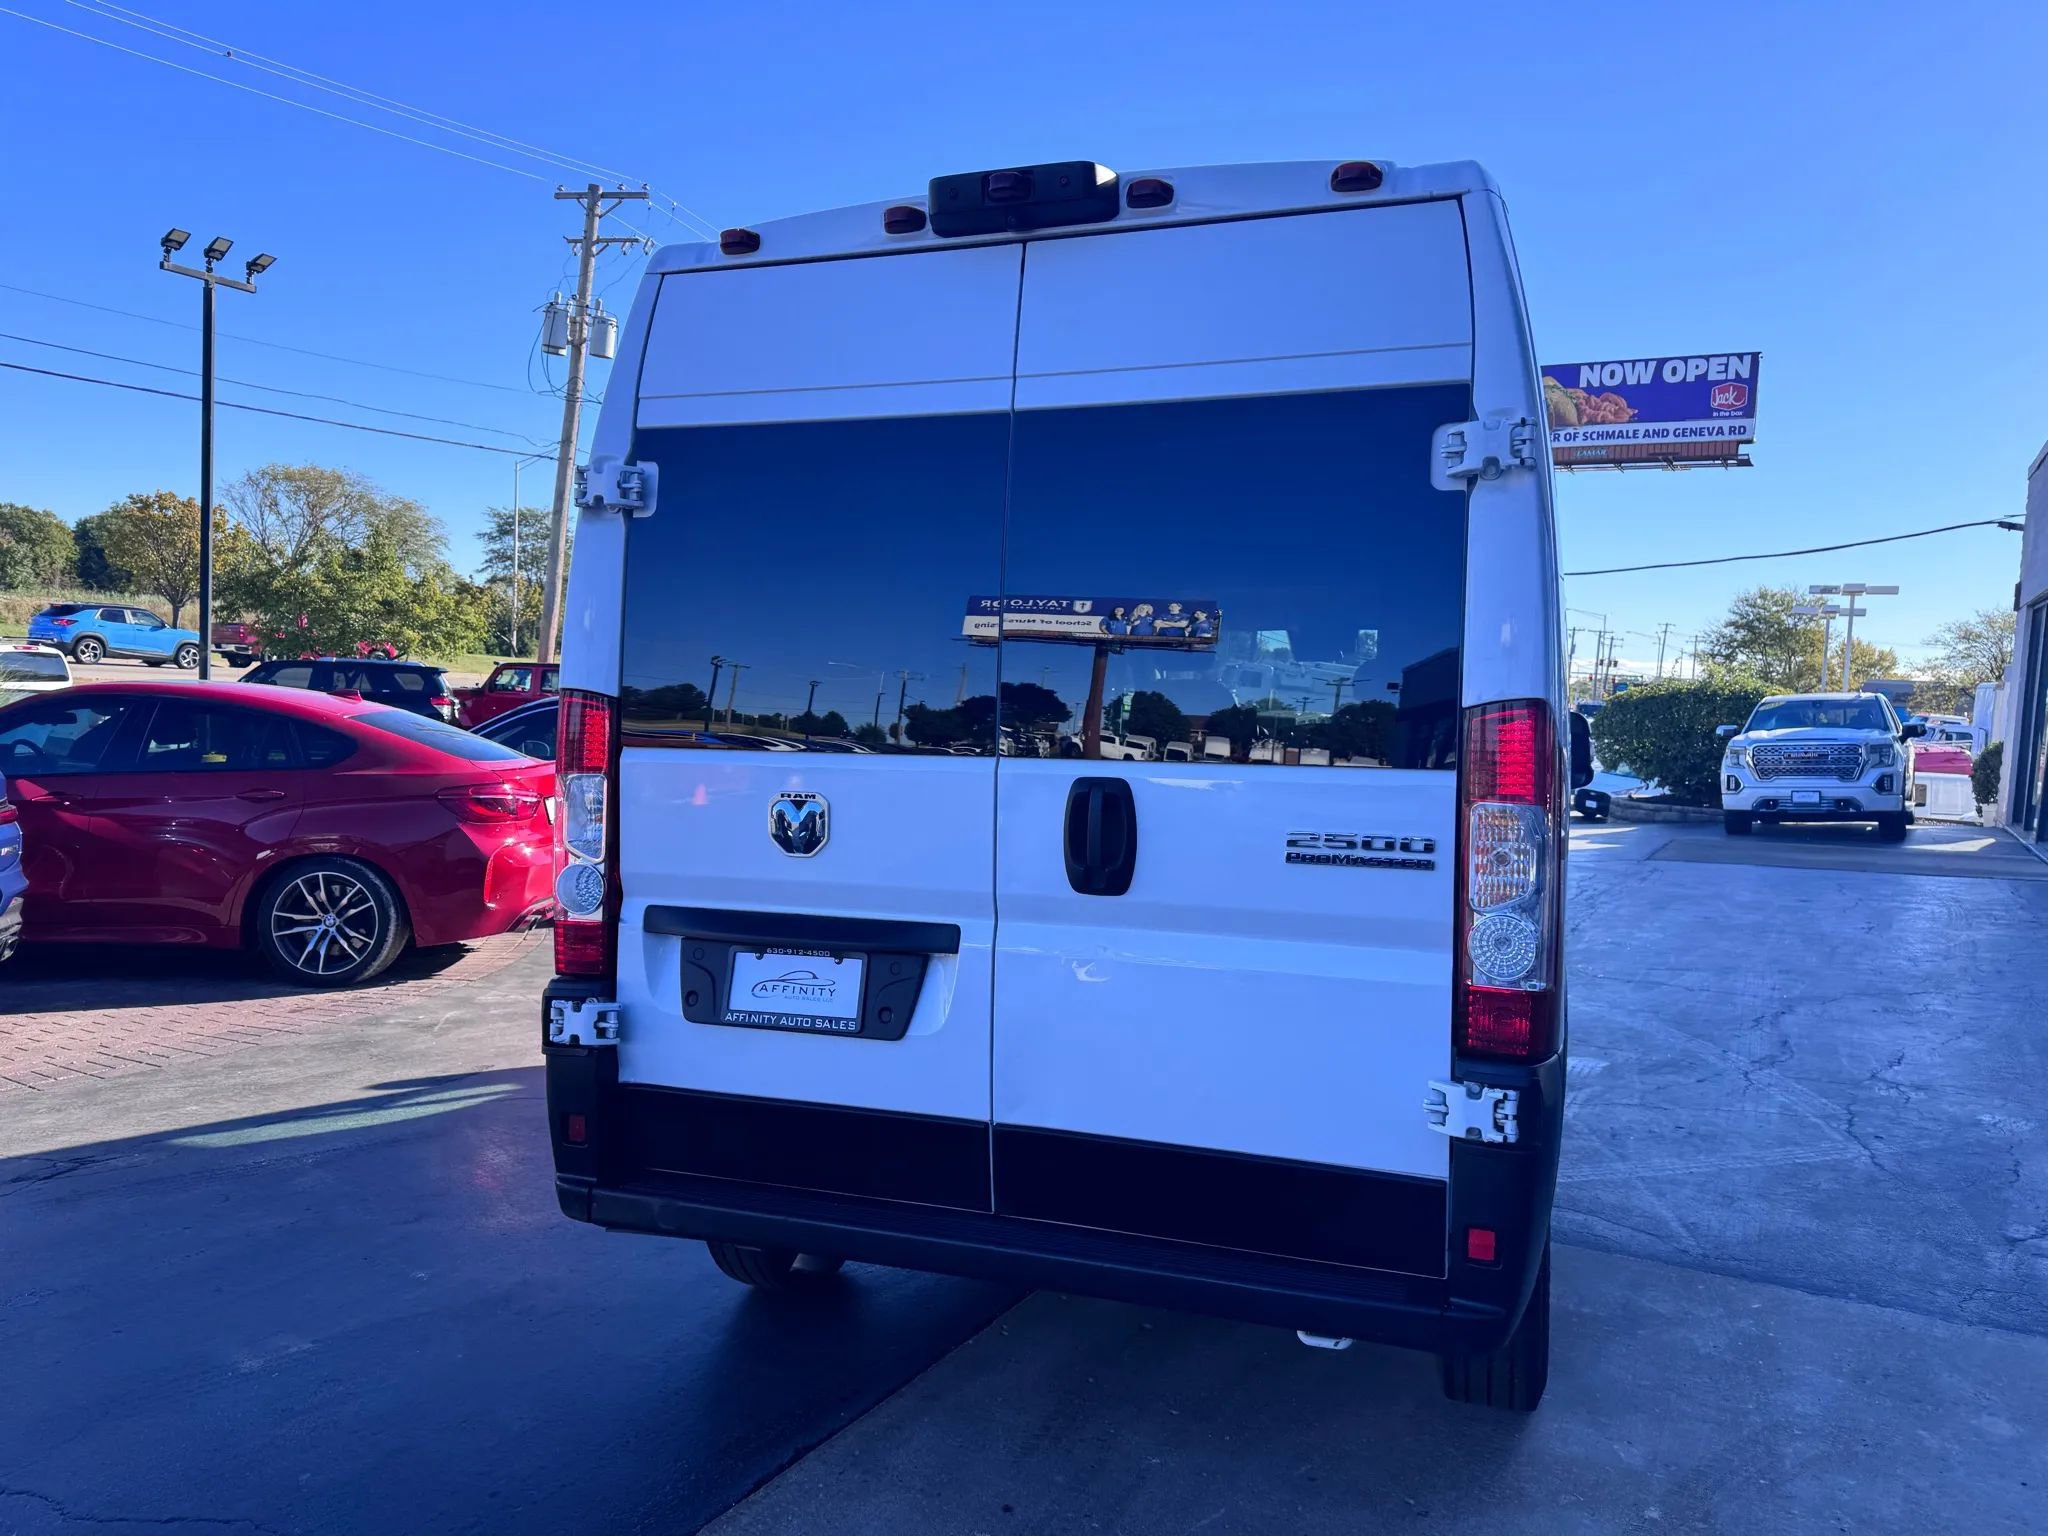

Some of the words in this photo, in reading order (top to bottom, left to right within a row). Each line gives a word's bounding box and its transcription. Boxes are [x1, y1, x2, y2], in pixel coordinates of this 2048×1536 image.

[1579, 360, 1656, 388] NOW
[1662, 354, 1752, 384] OPEN
[1712, 385, 1746, 406] Jack
[1563, 431, 1580, 442] OF
[1583, 428, 1640, 442] SCHMALE
[1642, 426, 1670, 439] AND
[1673, 425, 1725, 438] GENEVA
[1730, 424, 1747, 436] RD
[1286, 831, 1436, 853] 2500
[766, 947, 831, 957] 630-912-4500
[758, 983, 837, 997] AFFINITY
[724, 1012, 778, 1025] AFFINITY
[779, 1015, 811, 1028] AUTO
[815, 1018, 856, 1031] SALES
